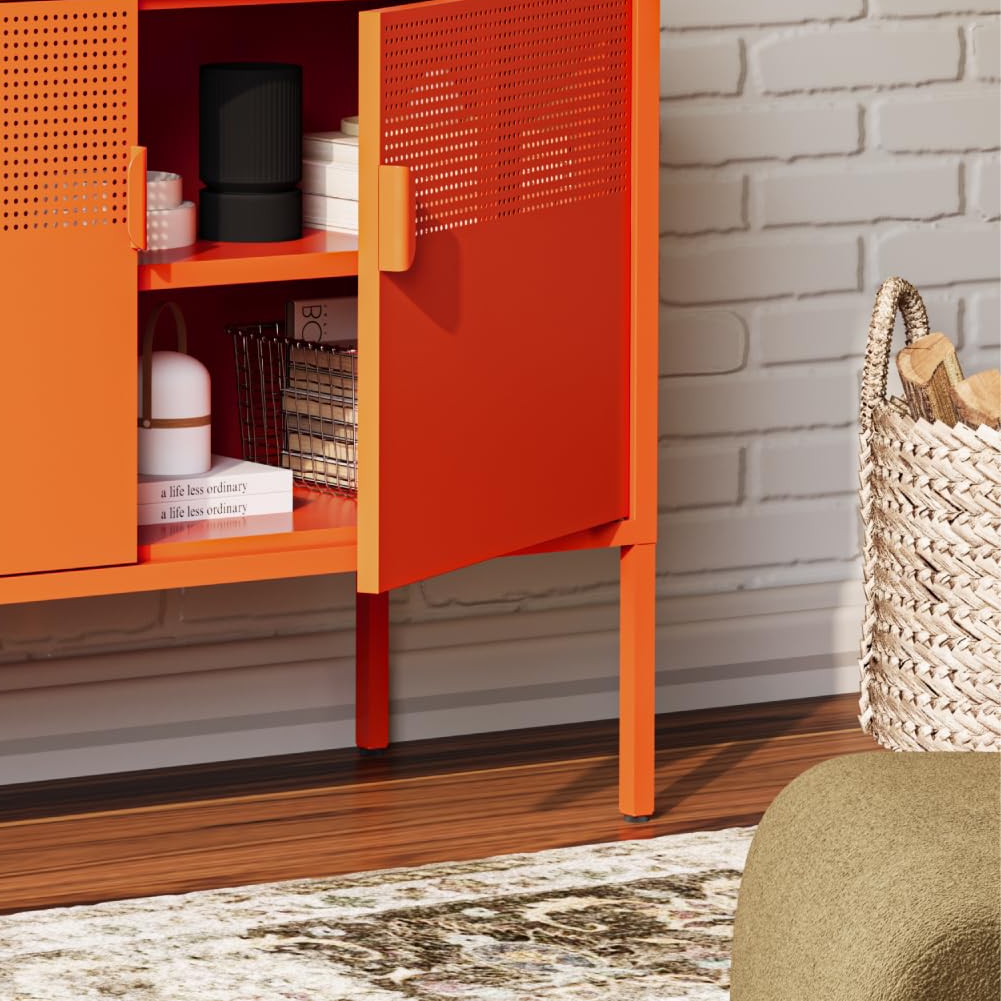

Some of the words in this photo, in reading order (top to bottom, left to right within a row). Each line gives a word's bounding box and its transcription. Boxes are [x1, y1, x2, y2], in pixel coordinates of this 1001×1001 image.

[160, 489, 167, 498] a
[169, 485, 185, 498] life
[187, 484, 204, 496] less
[206, 481, 248, 494] ordinary
[160, 510, 167, 520] a
[169, 506, 185, 519] life
[187, 505, 204, 517] less
[206, 502, 248, 515] ordinary
